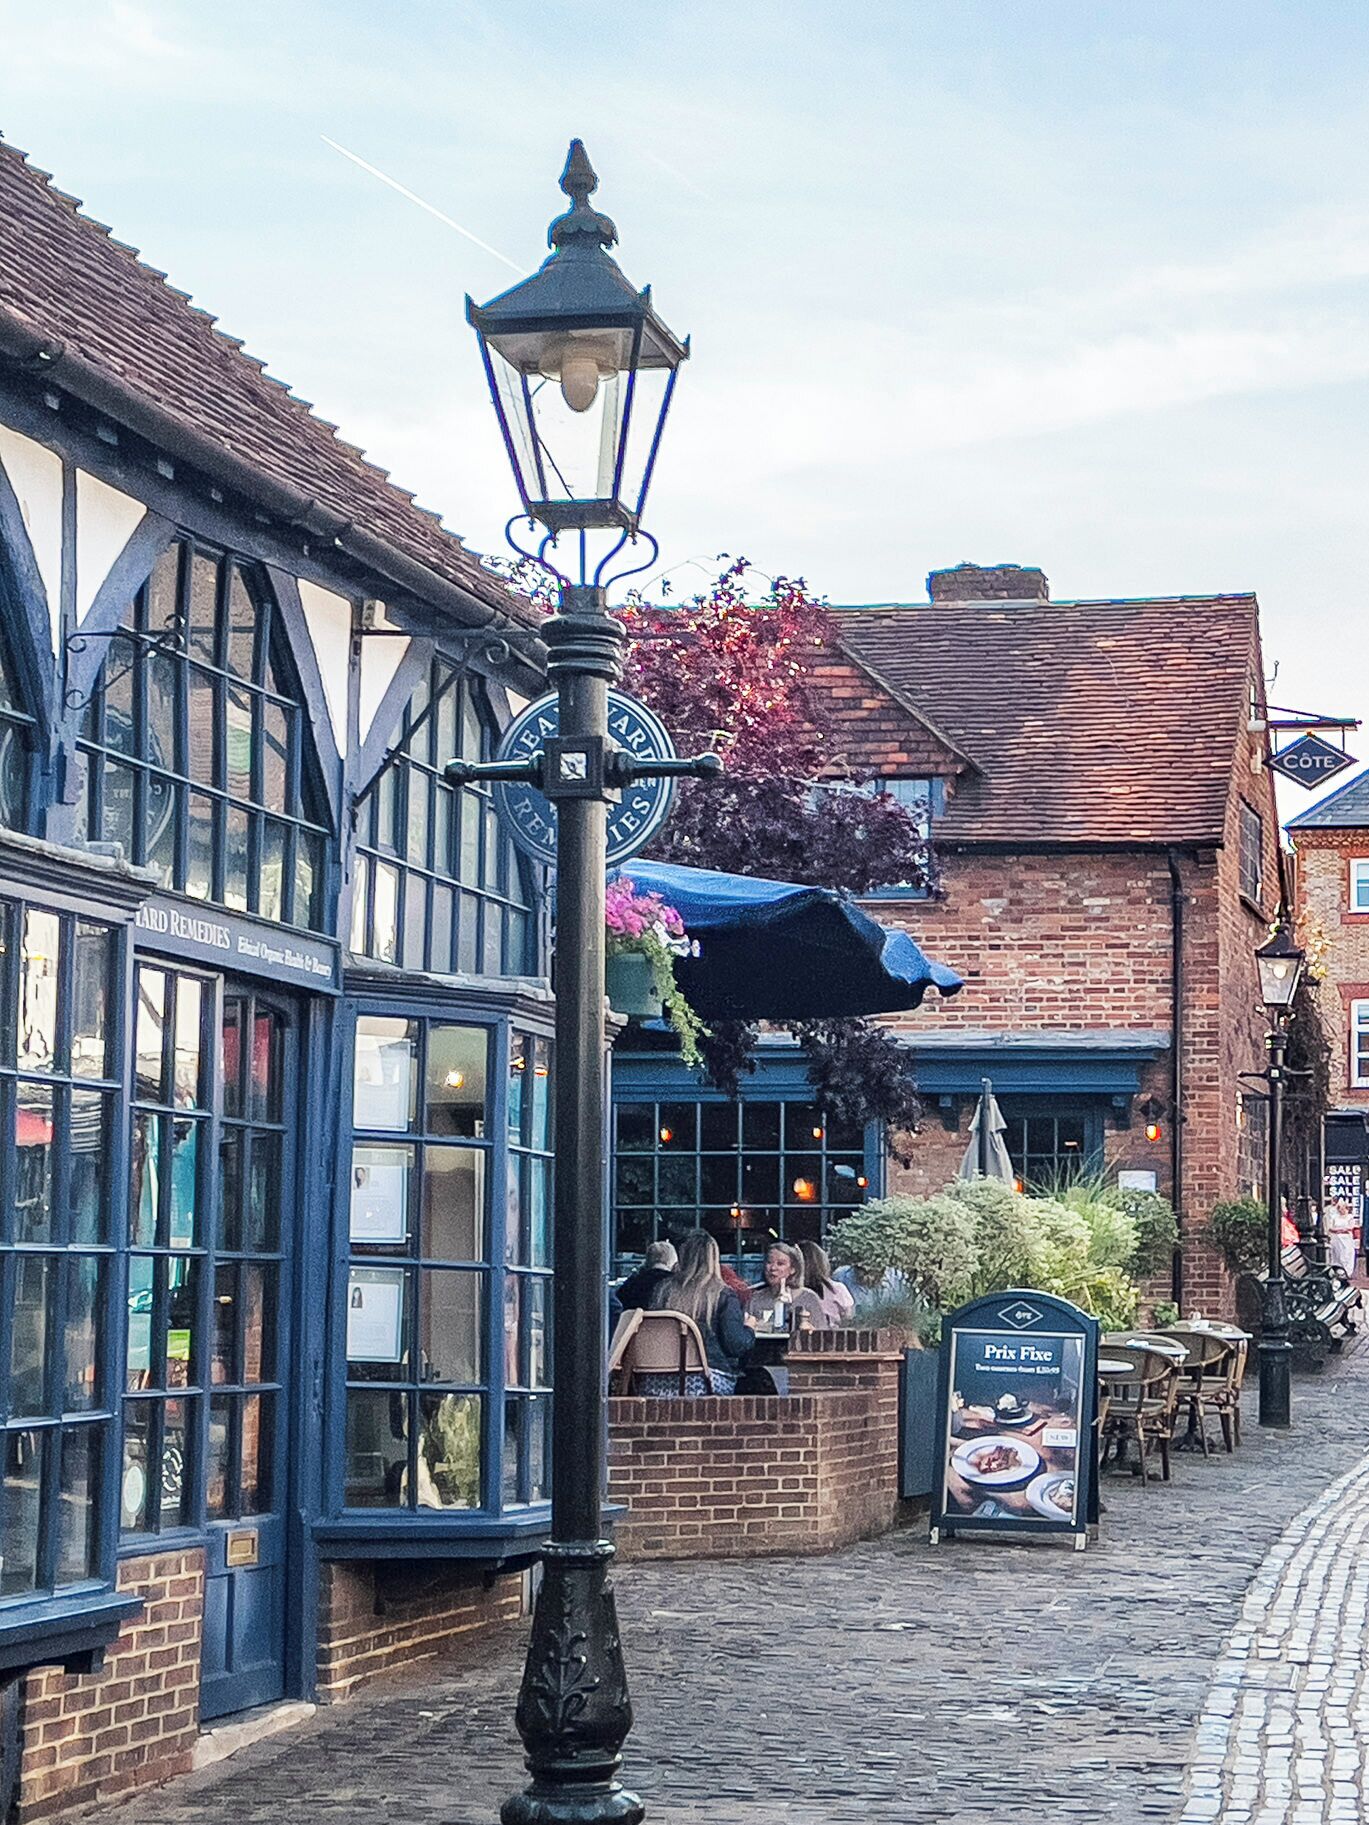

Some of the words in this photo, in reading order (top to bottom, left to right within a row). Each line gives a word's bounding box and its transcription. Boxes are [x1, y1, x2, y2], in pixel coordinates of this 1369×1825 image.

[1283, 753, 1335, 769] CÔTE
[170, 910, 231, 949] REMEDIES
[1329, 1176, 1360, 1186] SALE
[1329, 1186, 1360, 1197] SALE
[984, 1344, 1017, 1360] Prix
[1020, 1346, 1053, 1362] Fixe
